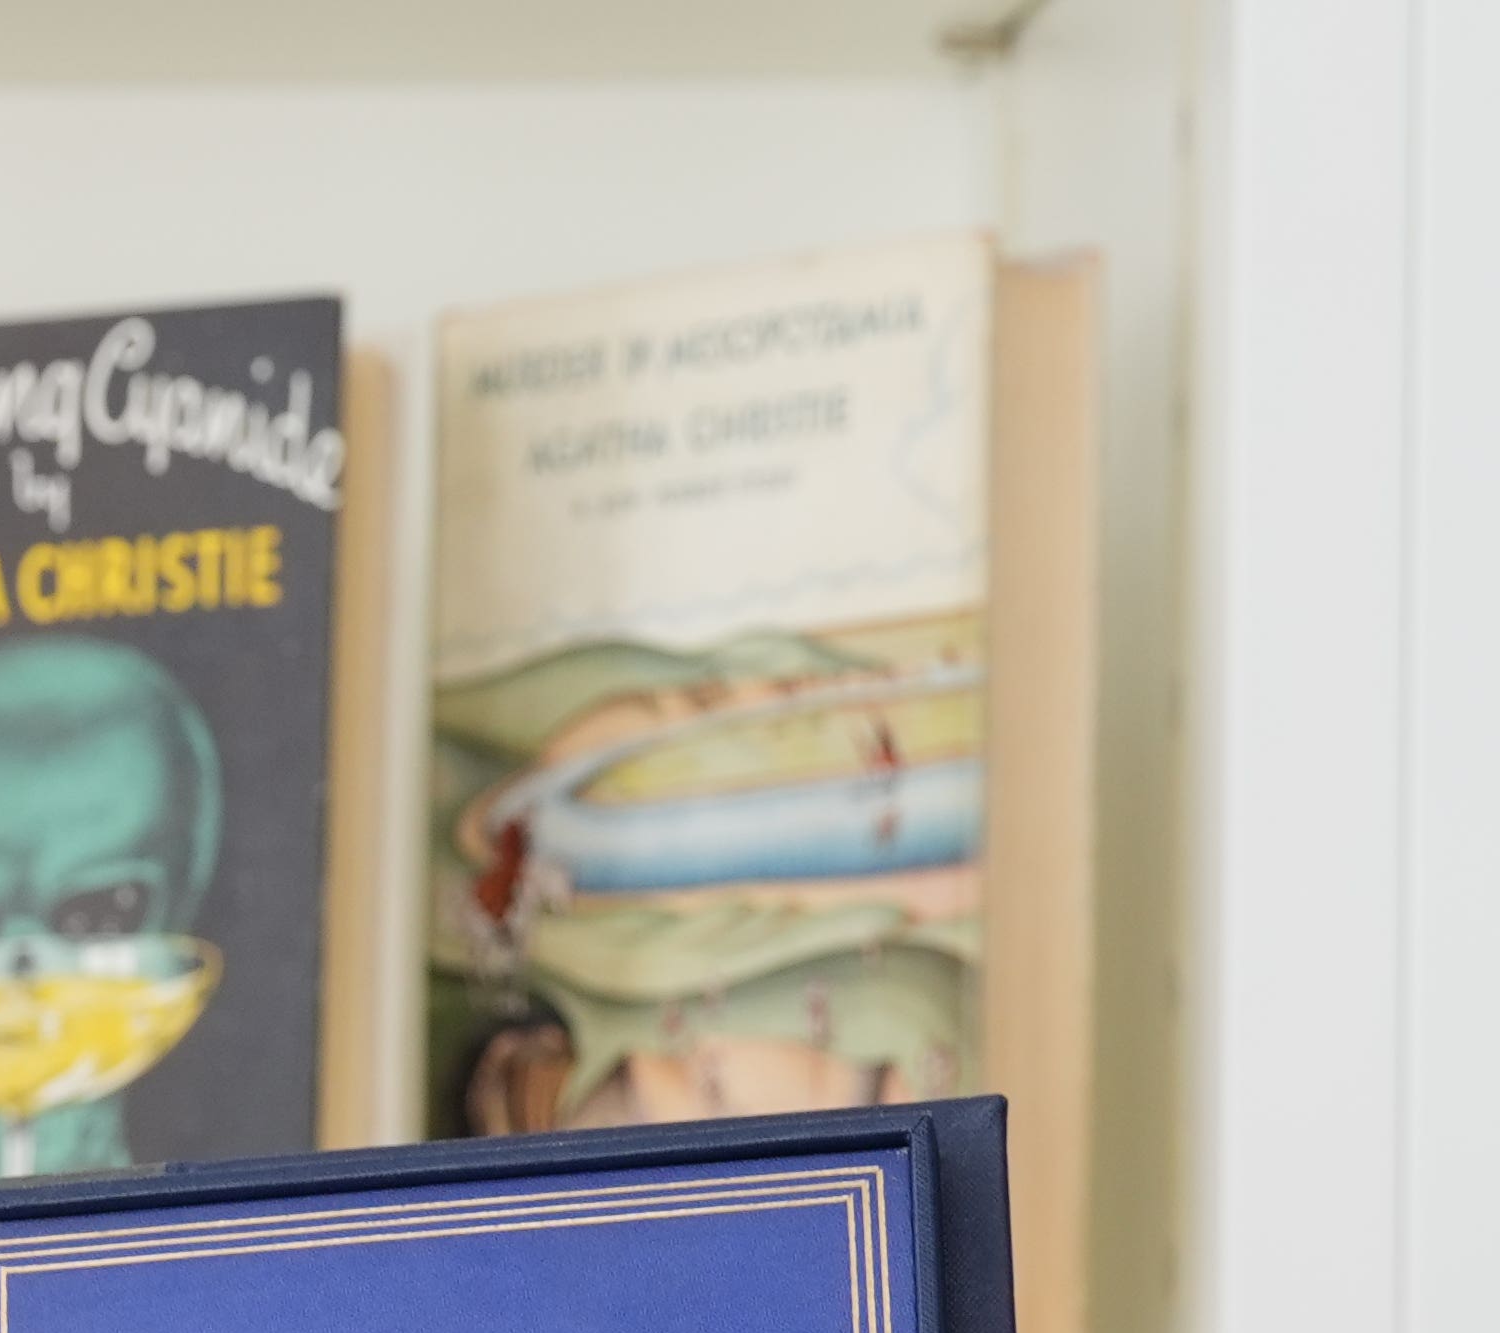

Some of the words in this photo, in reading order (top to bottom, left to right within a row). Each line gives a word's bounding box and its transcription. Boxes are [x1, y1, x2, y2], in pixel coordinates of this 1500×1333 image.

[83, 315, 348, 512] Cyanide
[8, 446, 73, 532] by
[15, 522, 285, 626] CHRISTIE
